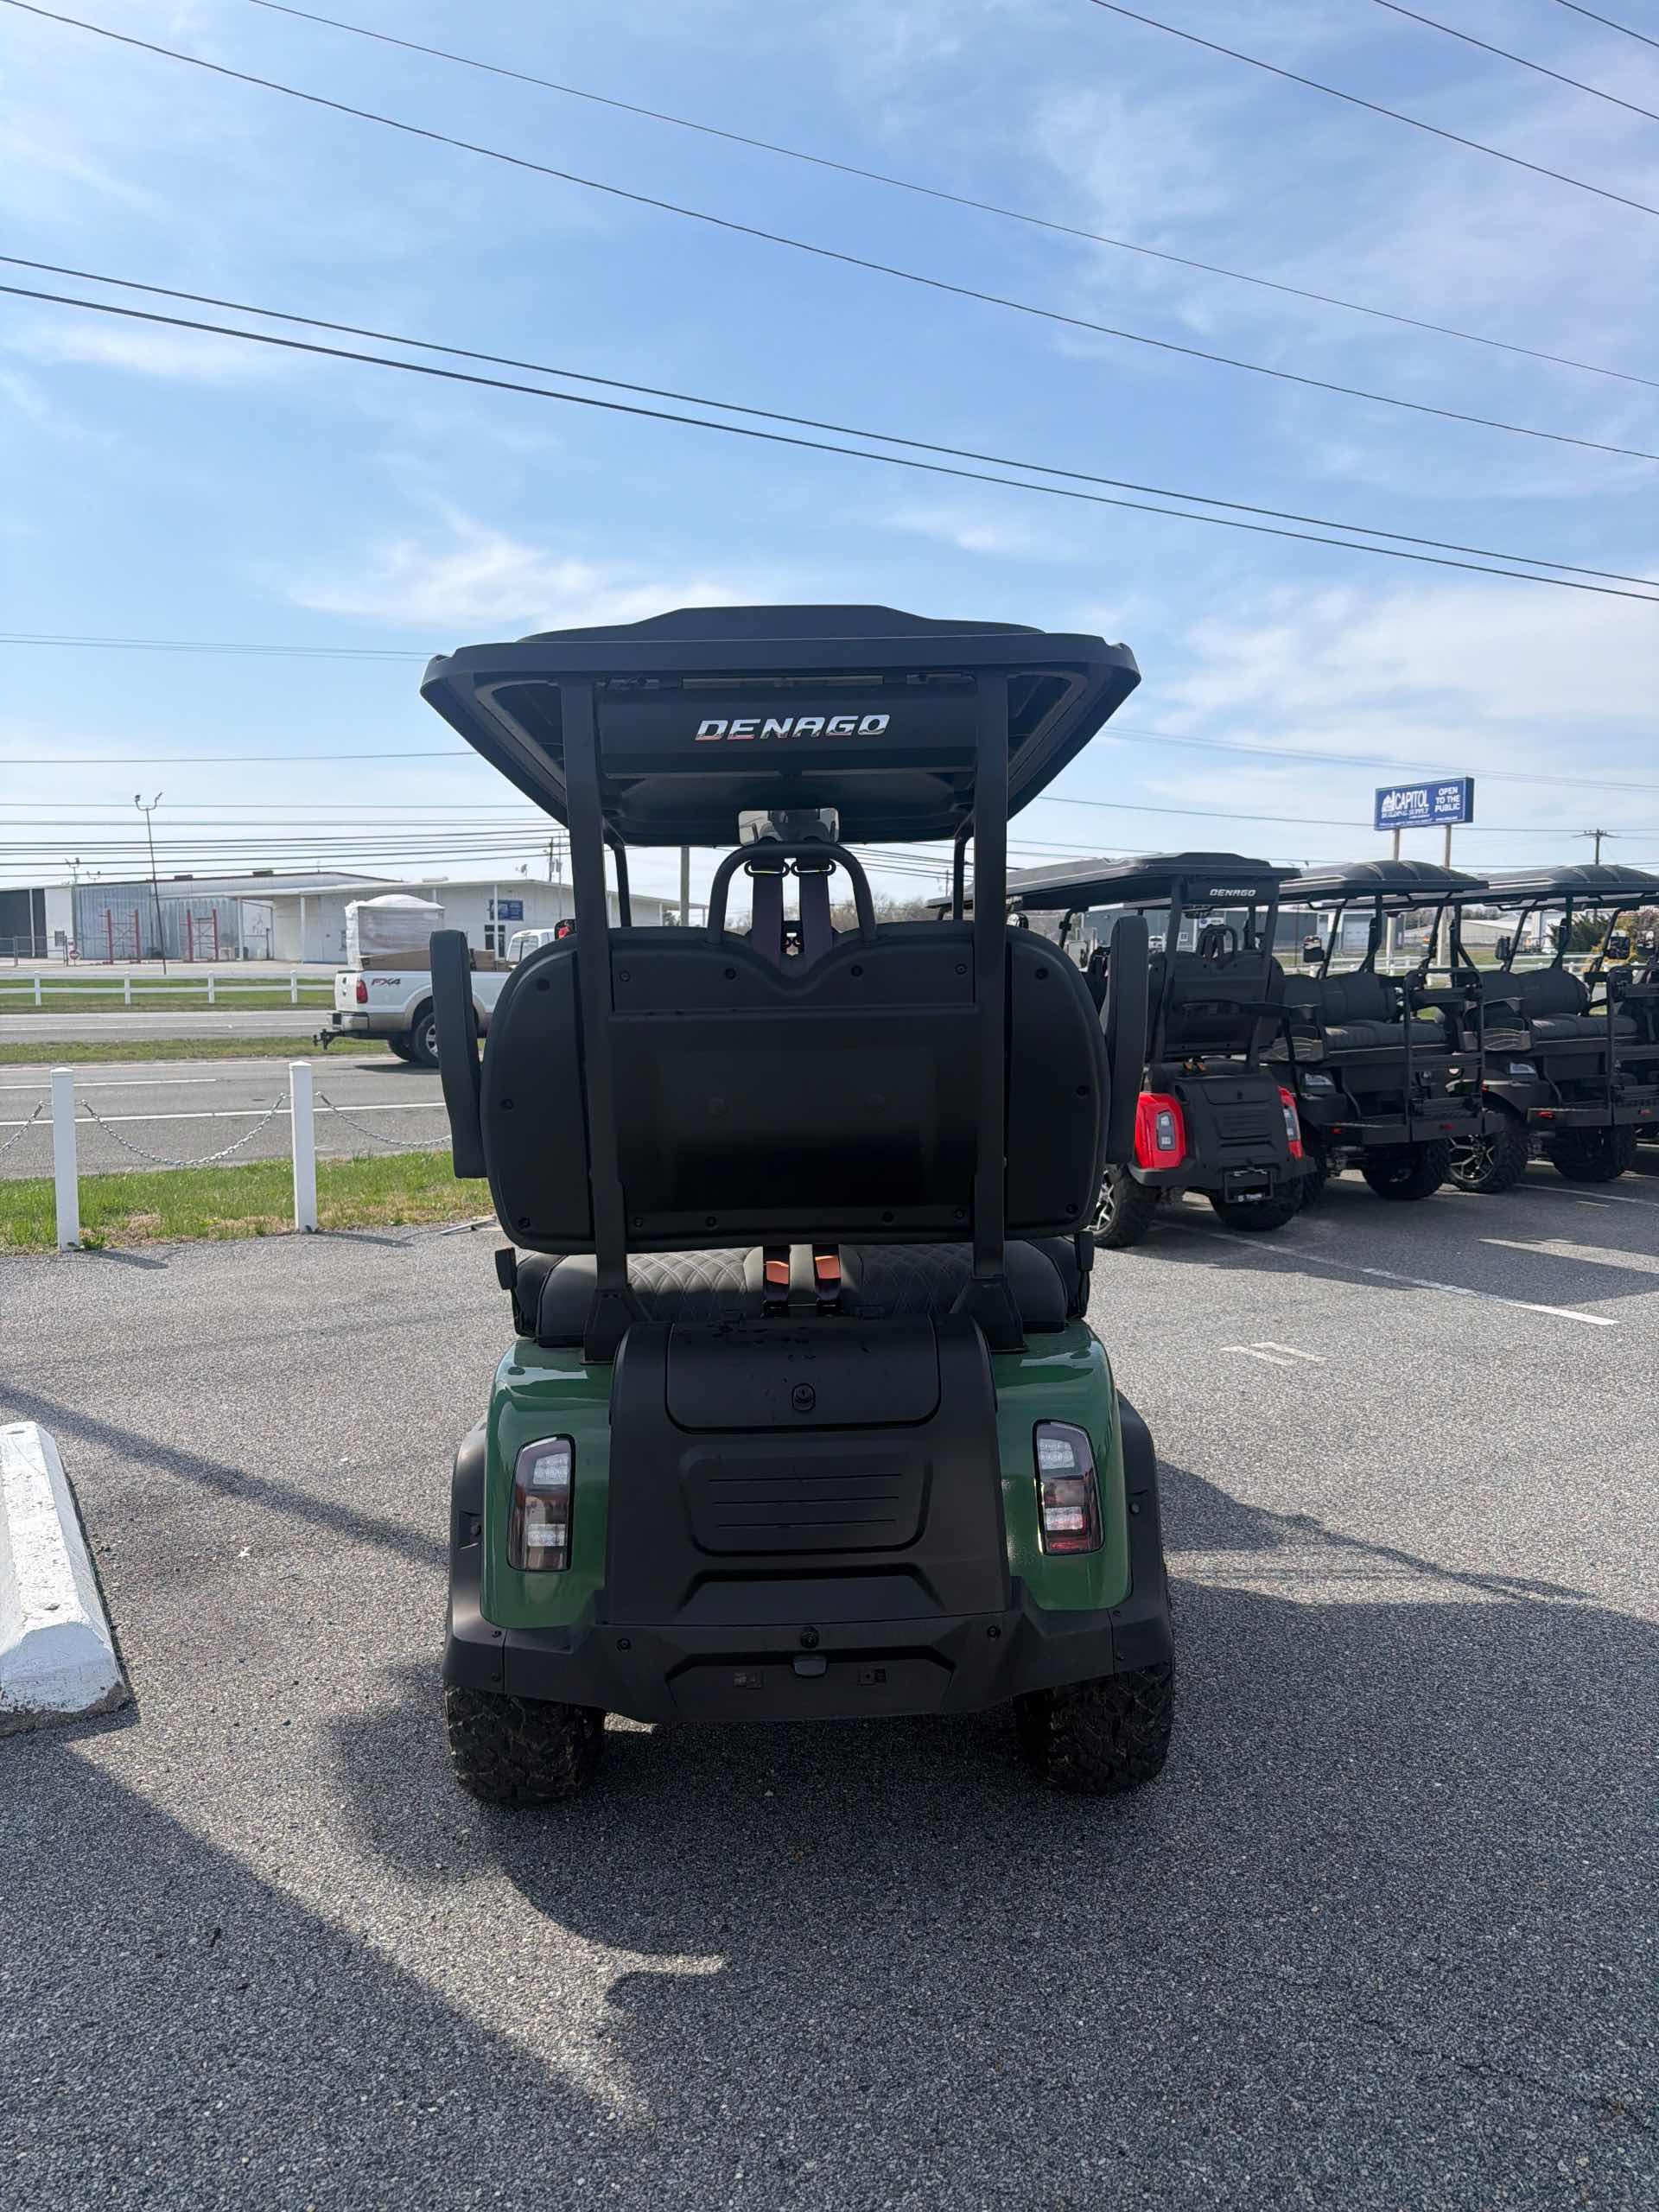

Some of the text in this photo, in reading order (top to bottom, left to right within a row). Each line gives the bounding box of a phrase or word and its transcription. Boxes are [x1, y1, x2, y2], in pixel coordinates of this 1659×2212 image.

[695, 714, 890, 741] DENAGO
[1439, 786, 1458, 795] OPEN
[1395, 790, 1429, 810] CAPITOL
[1408, 807, 1430, 816] SUPPLY
[1434, 804, 1460, 812] PUBLIC
[1209, 888, 1256, 897] DENAGO
